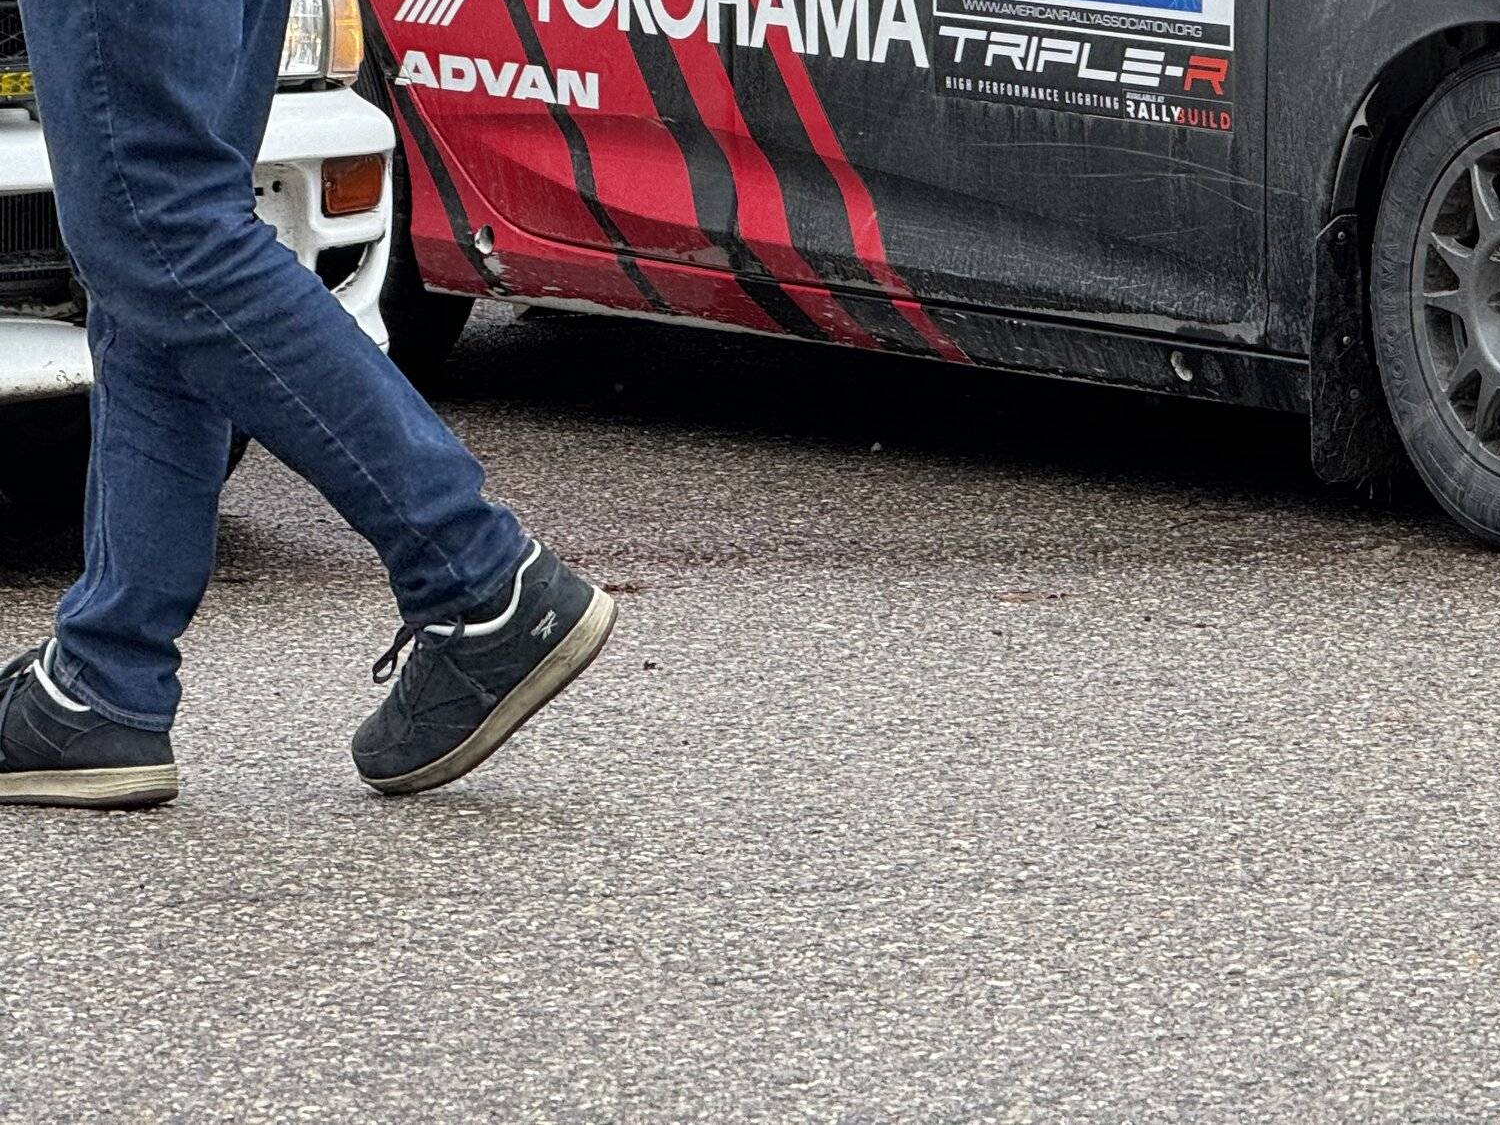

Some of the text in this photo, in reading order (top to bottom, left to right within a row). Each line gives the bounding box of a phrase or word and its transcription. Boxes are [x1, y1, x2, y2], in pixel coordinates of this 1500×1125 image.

[395, 49, 600, 110] ADVAN
[937, 25, 1230, 96] TRIPLE-R
[945, 75, 1121, 111] HIGH PERFORMANCE LIGHTING
